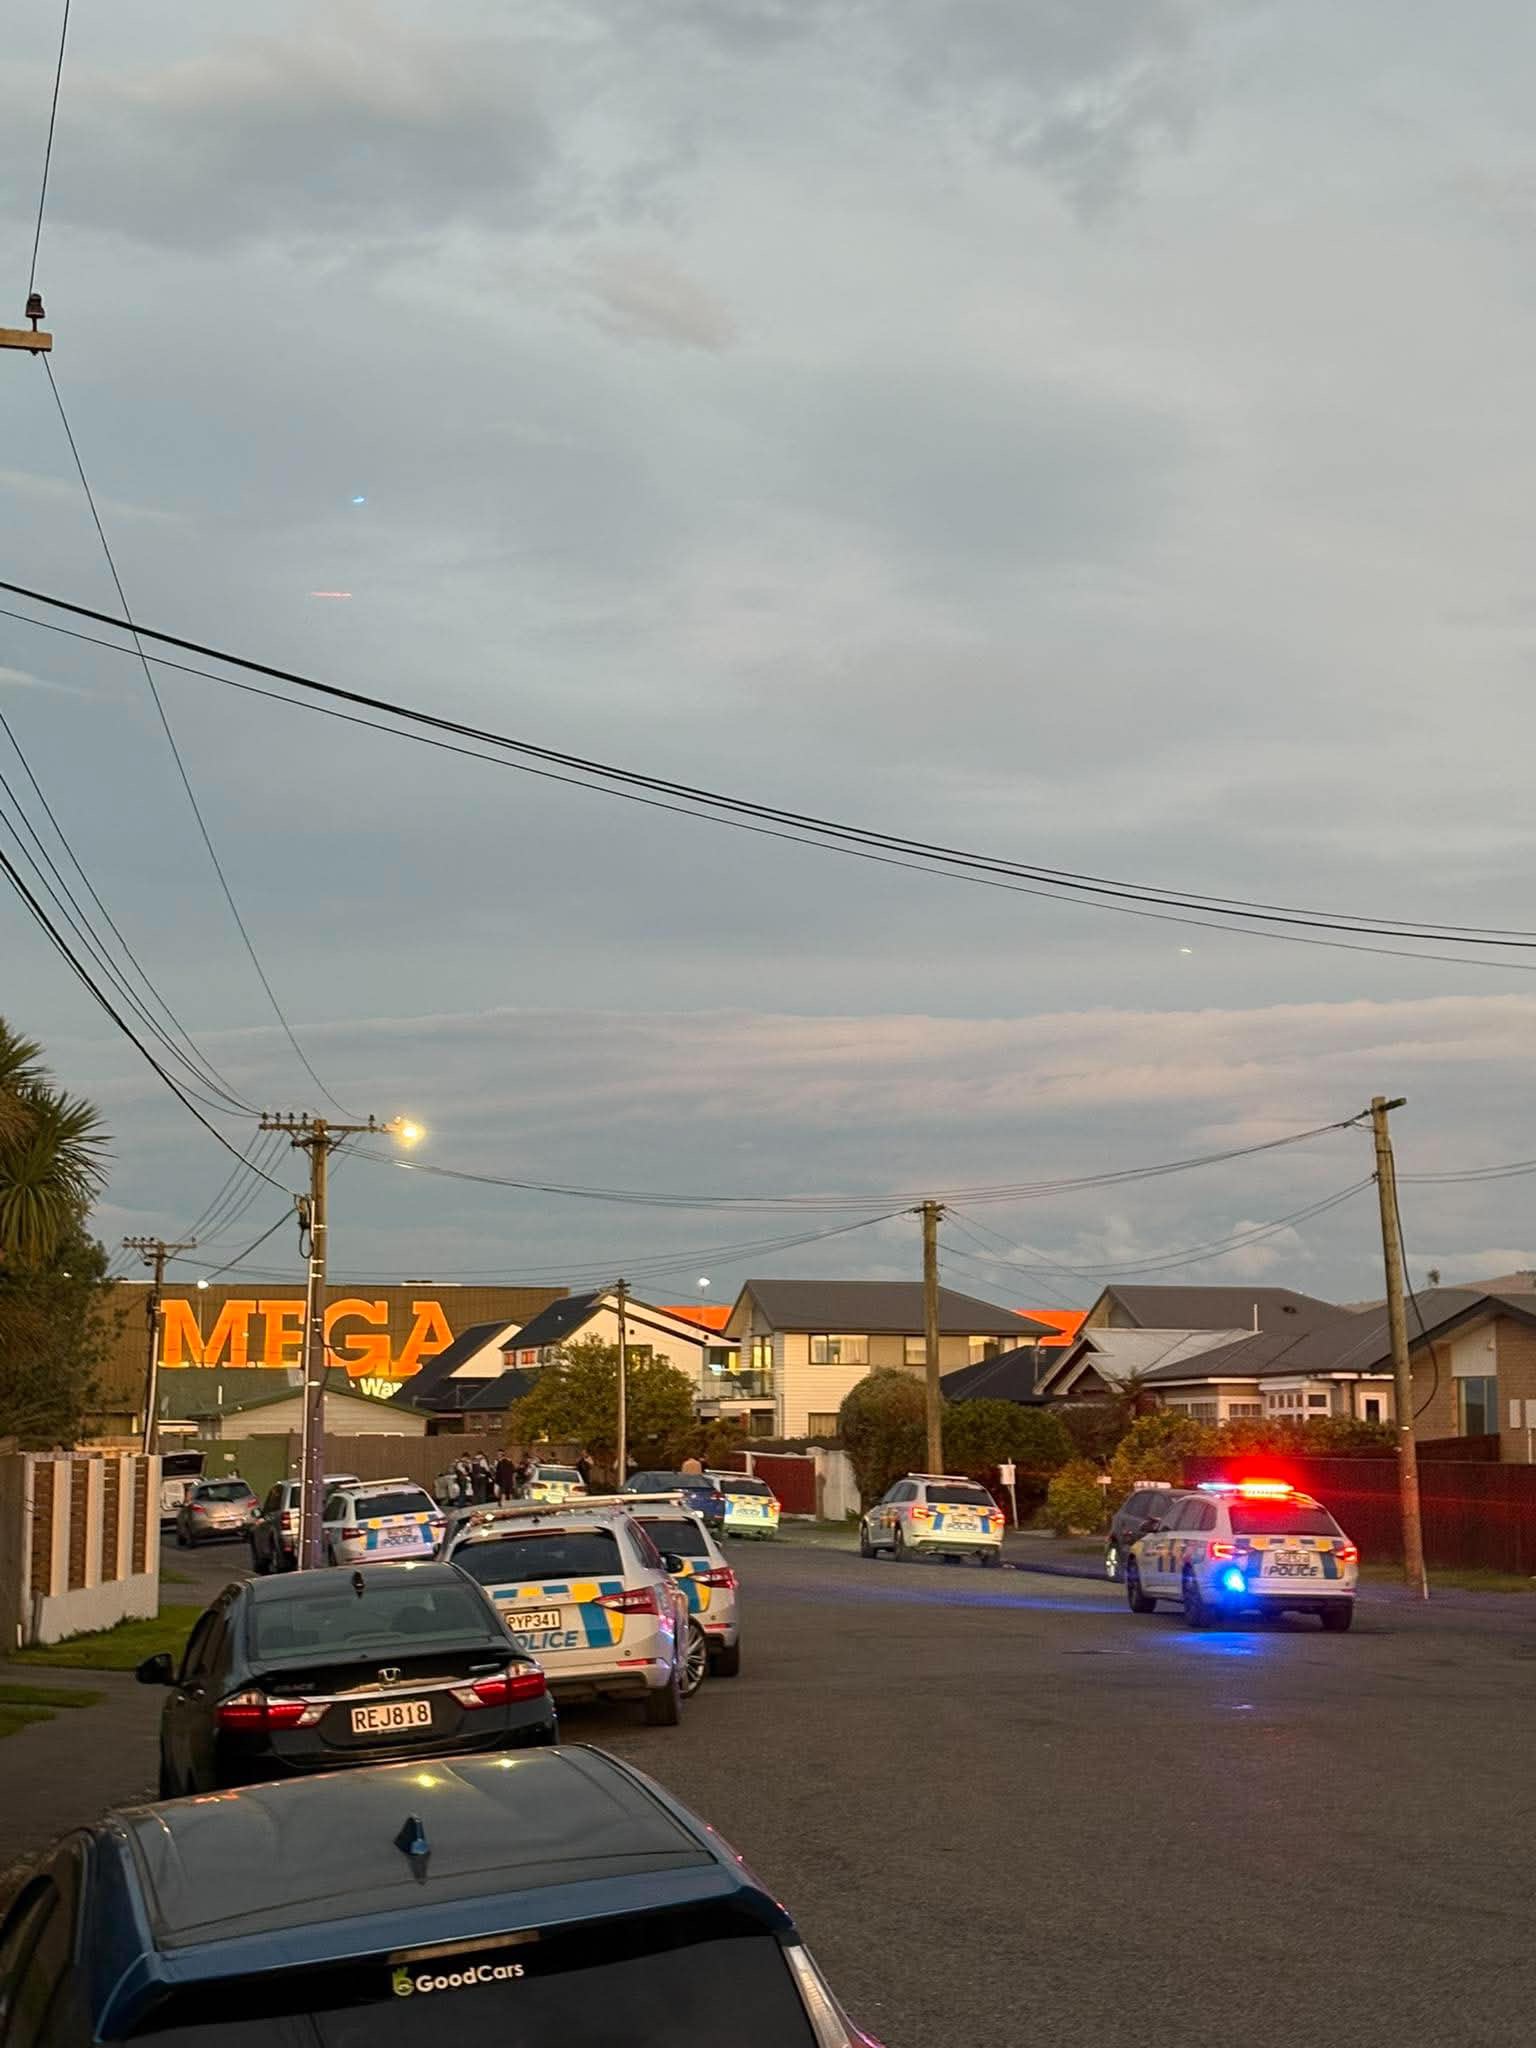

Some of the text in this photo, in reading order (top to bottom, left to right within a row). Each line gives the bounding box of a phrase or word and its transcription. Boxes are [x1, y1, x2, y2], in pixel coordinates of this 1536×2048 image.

[158, 1298, 454, 1377] MEGA
[1268, 1565, 1319, 1577] POLICE
[507, 1612, 556, 1629] PYP341
[514, 1630, 578, 1649] OLICE
[354, 1704, 430, 1730] REJ818
[415, 1963, 525, 1992] GoodCars
